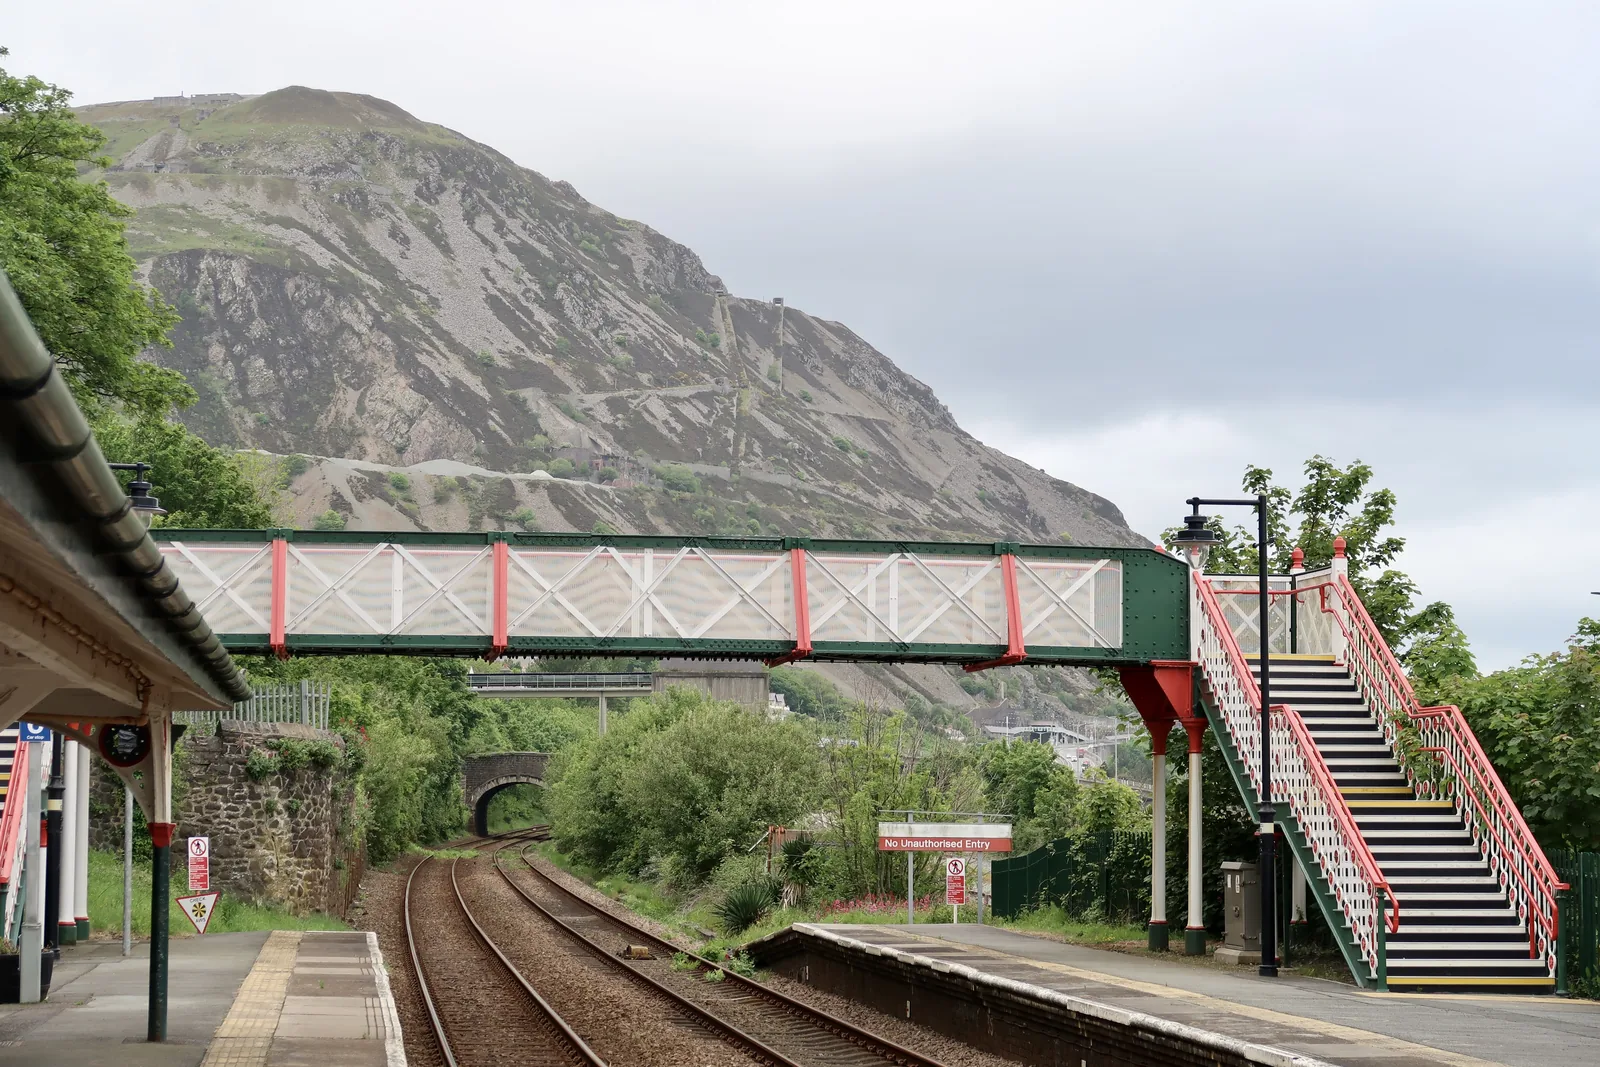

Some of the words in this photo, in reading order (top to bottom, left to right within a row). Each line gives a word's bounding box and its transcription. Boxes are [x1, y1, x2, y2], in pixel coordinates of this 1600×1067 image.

[885, 839, 898, 848] No
[901, 839, 963, 848] Unauthorised
[966, 840, 990, 850] Entry
